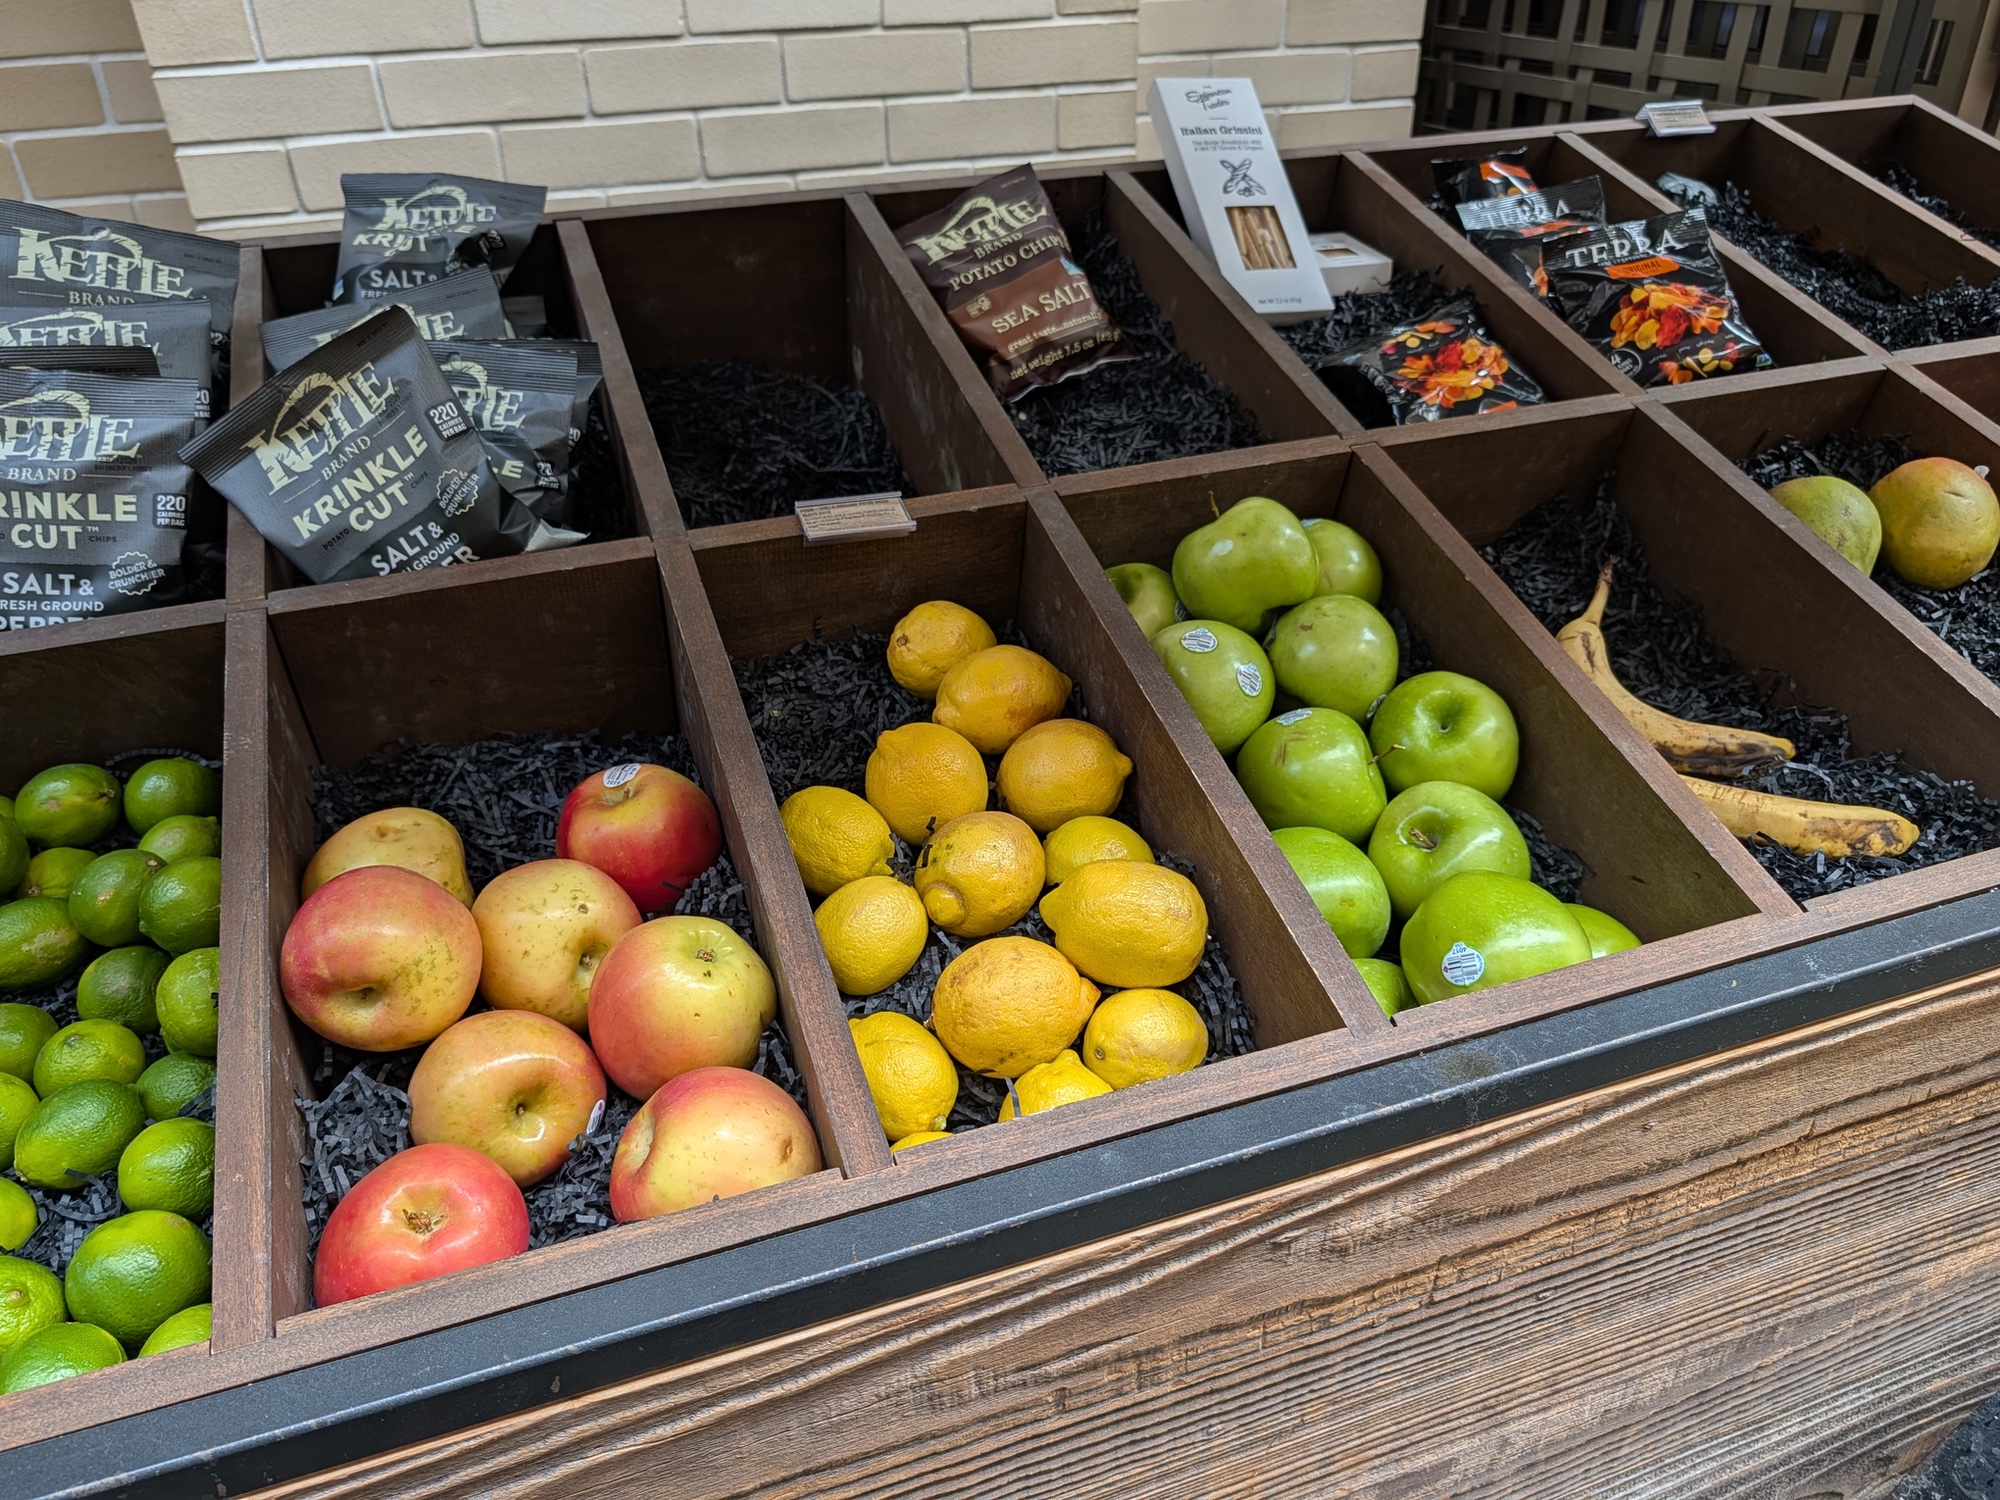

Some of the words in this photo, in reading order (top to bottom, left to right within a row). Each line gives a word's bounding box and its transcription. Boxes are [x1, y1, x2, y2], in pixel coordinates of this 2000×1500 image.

[1180, 126, 1217, 136] Italian
[1219, 126, 1263, 135] Grissini
[973, 231, 1023, 258] BRAND
[1565, 229, 1689, 268] TERRA
[9, 226, 193, 298] KETTLE
[950, 252, 1008, 291] POTATO
[1622, 260, 1662, 274] ORIGINAL
[370, 269, 427, 289] SALT
[991, 303, 1040, 334] SEA
[1038, 281, 1093, 313] SALT
[1007, 332, 1034, 353] great
[1010, 361, 1030, 380] net
[429, 401, 459, 425] 220
[438, 416, 463, 432] CALORIES
[240, 361, 396, 496] KETTLE
[321, 434, 372, 482] BRAND
[7, 468, 77, 481] BRAND
[292, 424, 429, 540] KRINKLE
[410, 470, 429, 490] CHIPS
[157, 495, 186, 511] 220
[438, 477, 463, 509] BOLDER
[445, 473, 480, 518] CRUNCHIER
[157, 518, 170, 526] PER
[322, 528, 350, 551] POTATO
[371, 524, 426, 577] SALT
[427, 521, 444, 539] &
[413, 532, 461, 573] GROUND
[108, 568, 166, 590] CRUNCHIER
[109, 562, 146, 579] BOLDER
[147, 559, 157, 568] &
[3, 572, 75, 595] SALT
[79, 579, 94, 596] &
[41, 601, 105, 612] GROUND
